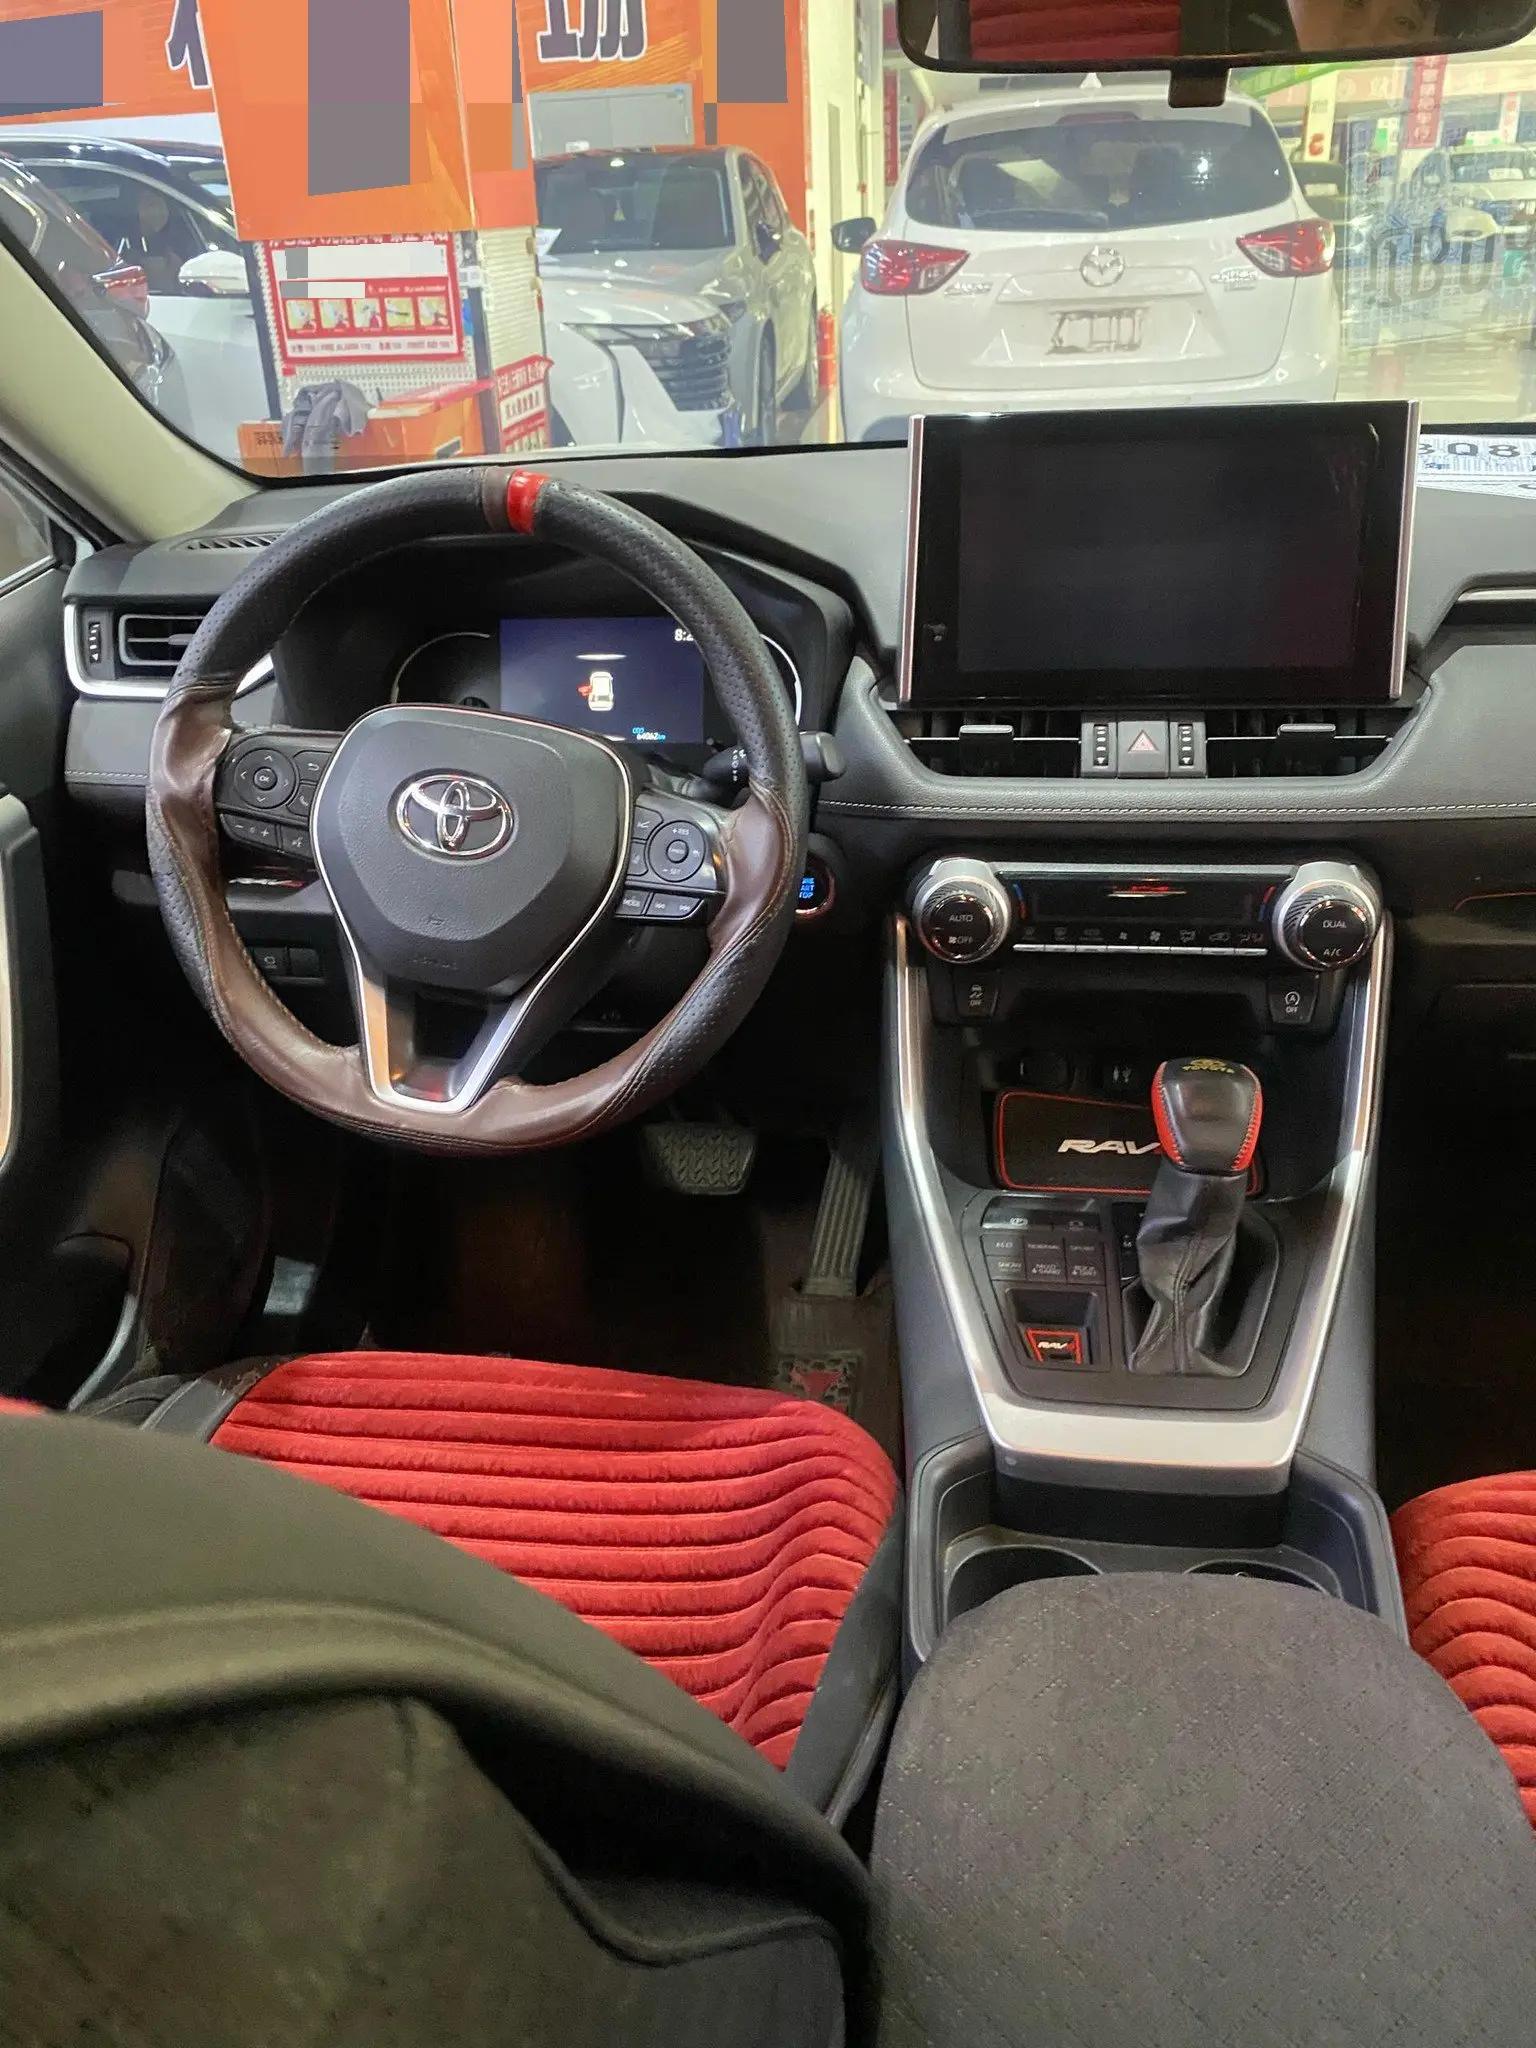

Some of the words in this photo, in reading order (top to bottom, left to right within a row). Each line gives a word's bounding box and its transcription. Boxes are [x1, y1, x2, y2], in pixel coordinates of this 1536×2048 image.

[949, 914, 974, 923] AUTO
[1322, 919, 1347, 929] DUAL
[956, 935, 974, 944] OFF
[1322, 947, 1343, 957] A/C
[1285, 1006, 1299, 1014] OFF
[1057, 1139, 1164, 1155] RAV
